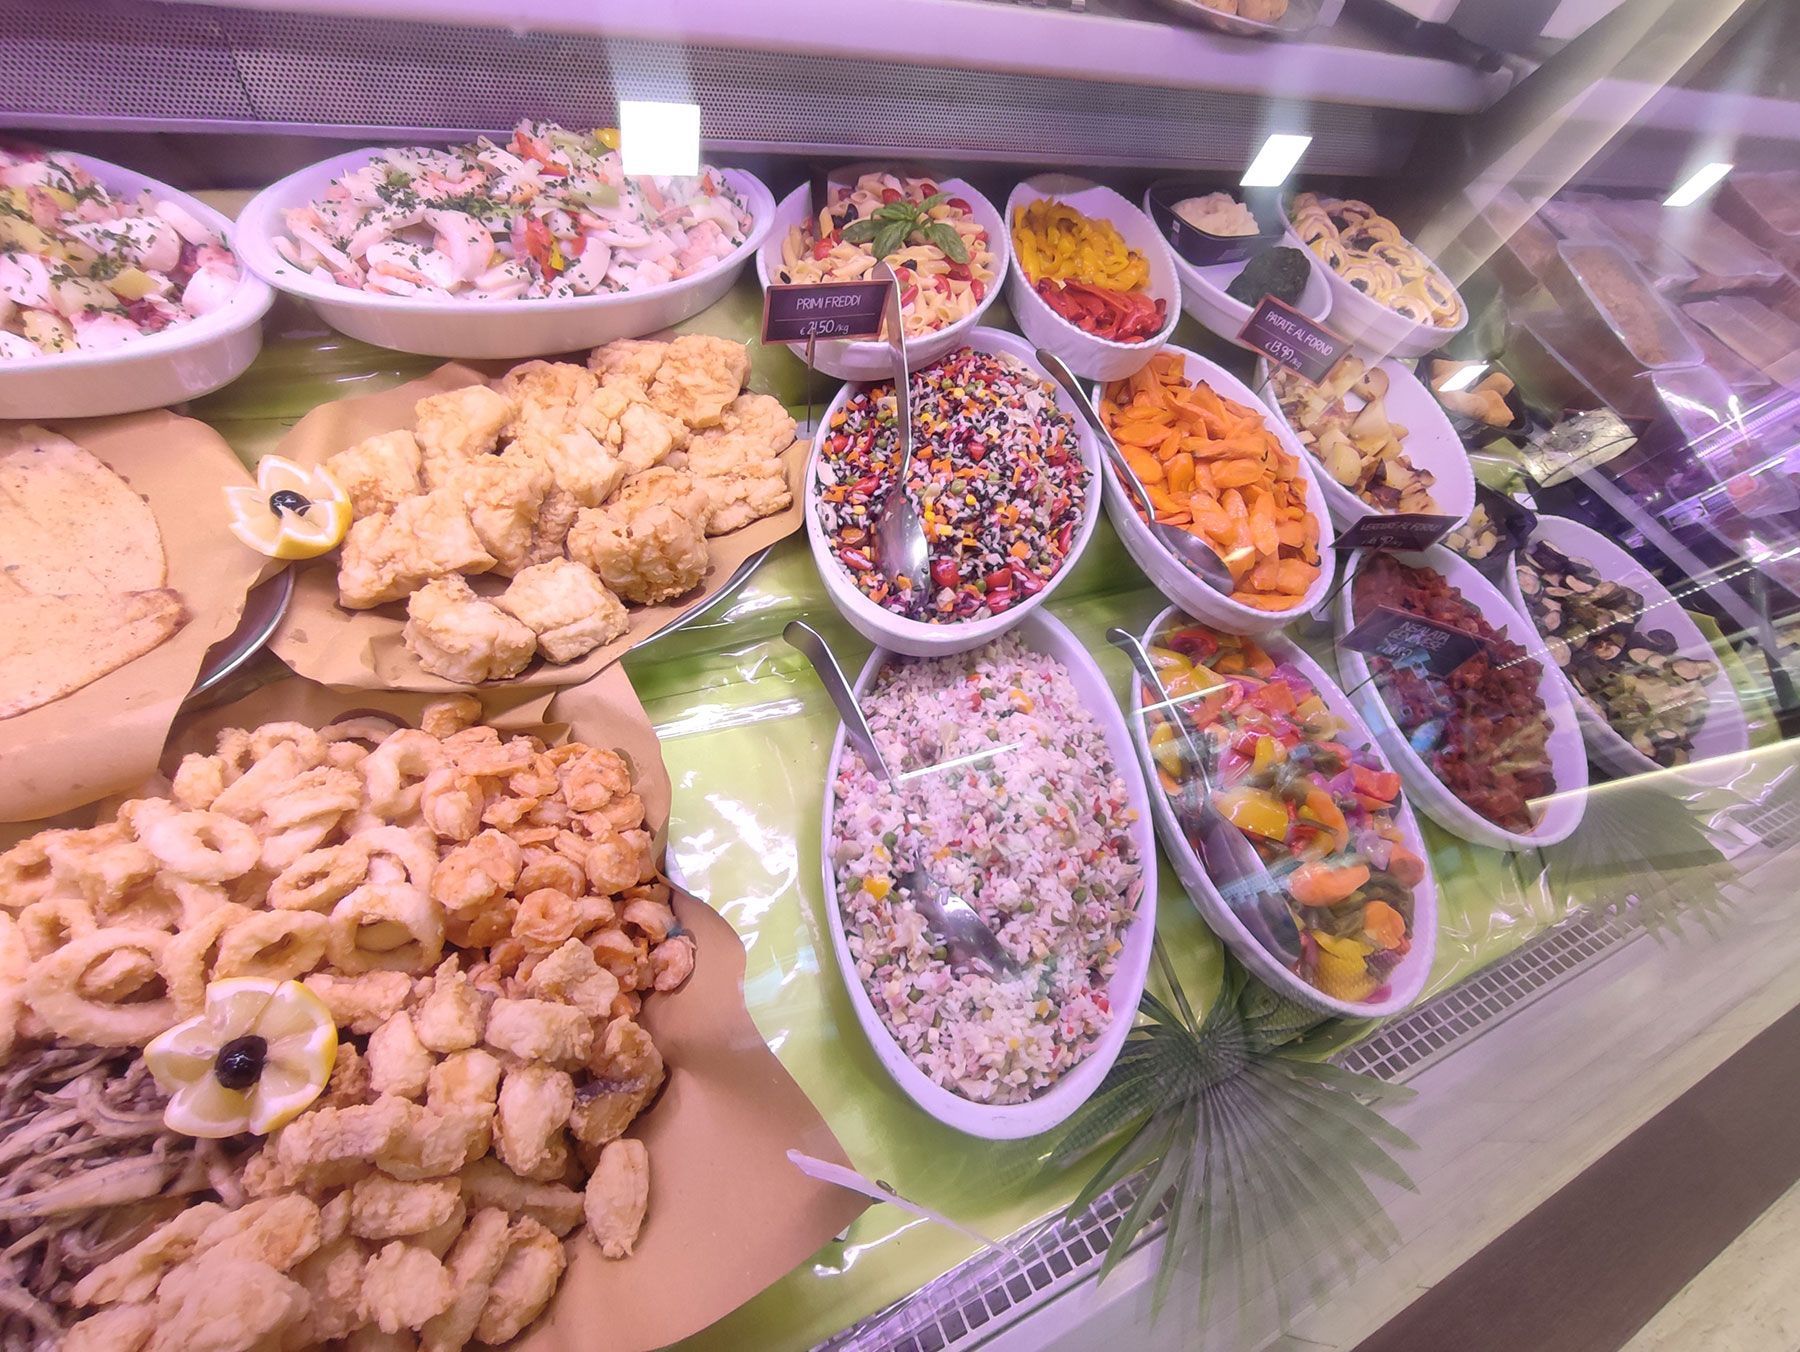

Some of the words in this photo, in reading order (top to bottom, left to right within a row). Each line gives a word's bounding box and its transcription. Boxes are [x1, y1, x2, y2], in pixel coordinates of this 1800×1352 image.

[796, 297, 824, 310] PRIMI
[824, 295, 862, 309] FREDDI
[1264, 310, 1297, 335] PATATE
[1291, 328, 1306, 341] AL
[1304, 335, 1334, 356] FORNO
